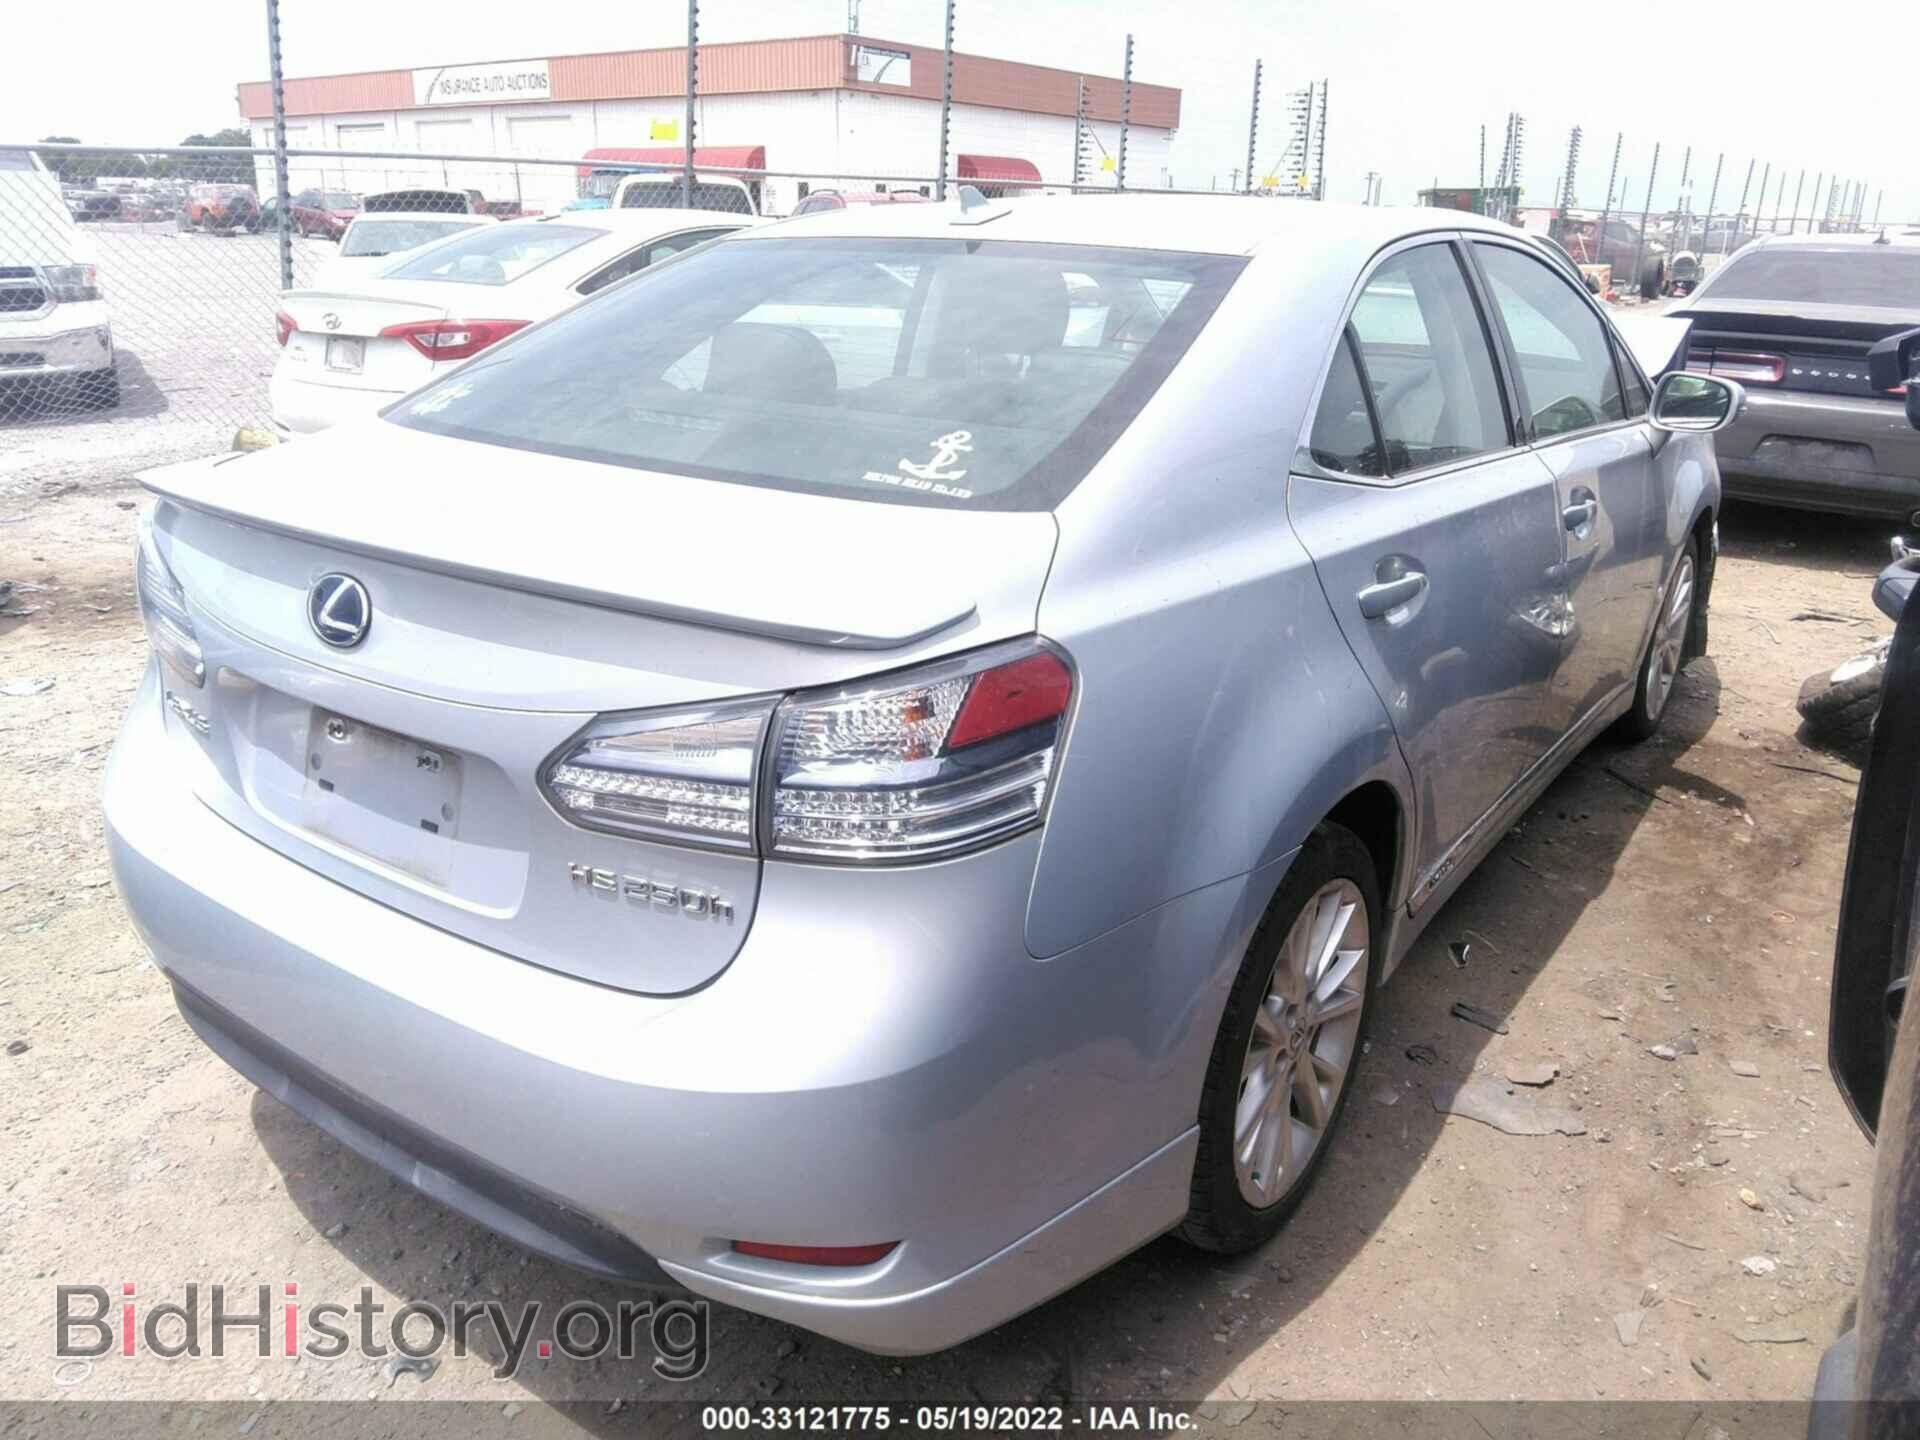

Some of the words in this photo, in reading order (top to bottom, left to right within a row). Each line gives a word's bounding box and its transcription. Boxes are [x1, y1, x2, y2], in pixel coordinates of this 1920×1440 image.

[483, 75, 505, 93] AUTO
[507, 72, 548, 91] AUCTIONS
[567, 861, 618, 893] HS
